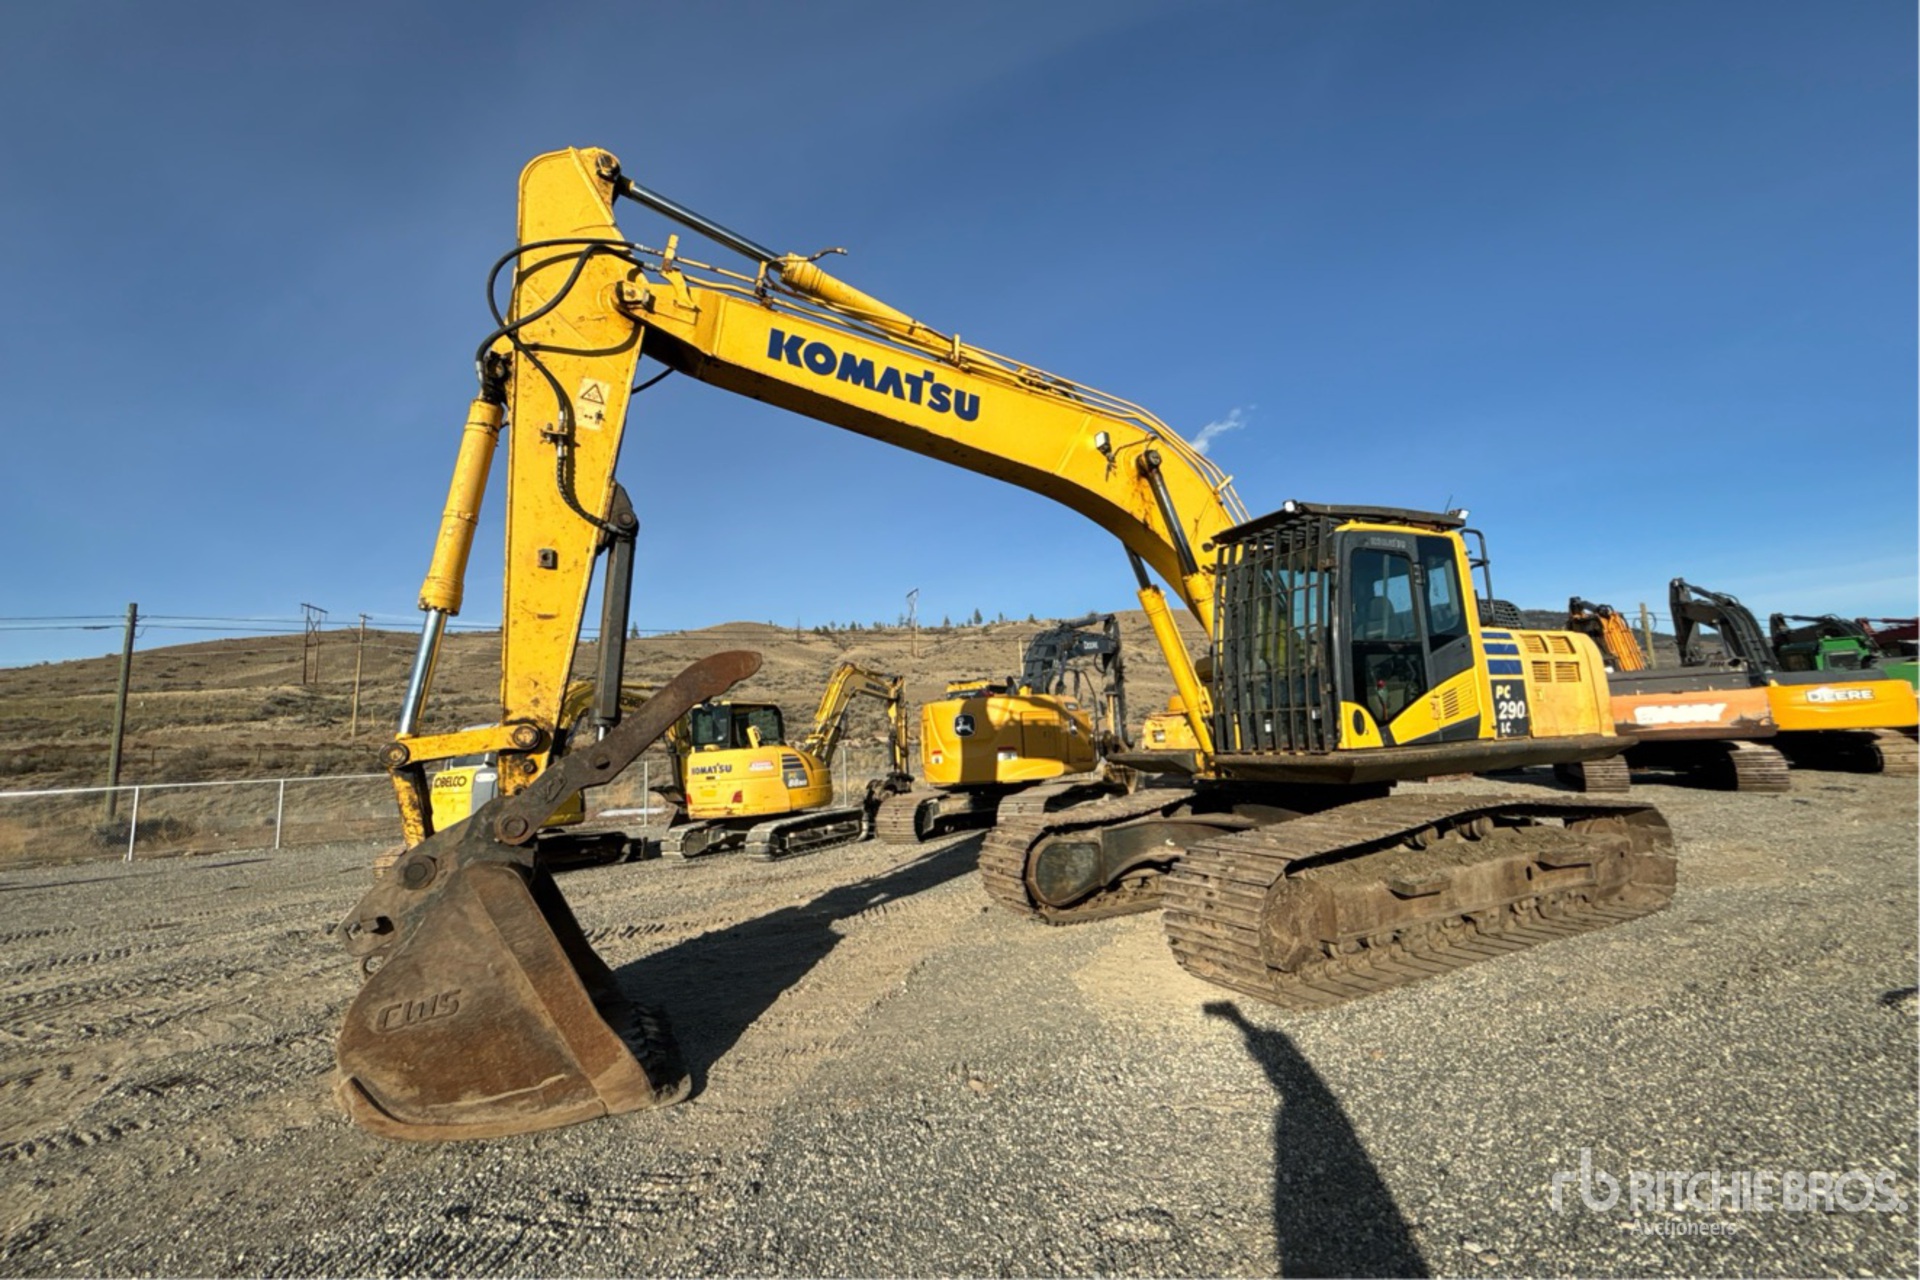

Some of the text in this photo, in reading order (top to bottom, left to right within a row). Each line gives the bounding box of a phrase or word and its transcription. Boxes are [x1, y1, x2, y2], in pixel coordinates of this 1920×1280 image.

[767, 328, 980, 422] KOMATSU
[1495, 685, 1511, 699] PC
[1806, 688, 1874, 702] DEERE
[1498, 701, 1525, 719] 290
[1501, 722, 1511, 733] LC
[434, 775, 467, 788] OBELCO
